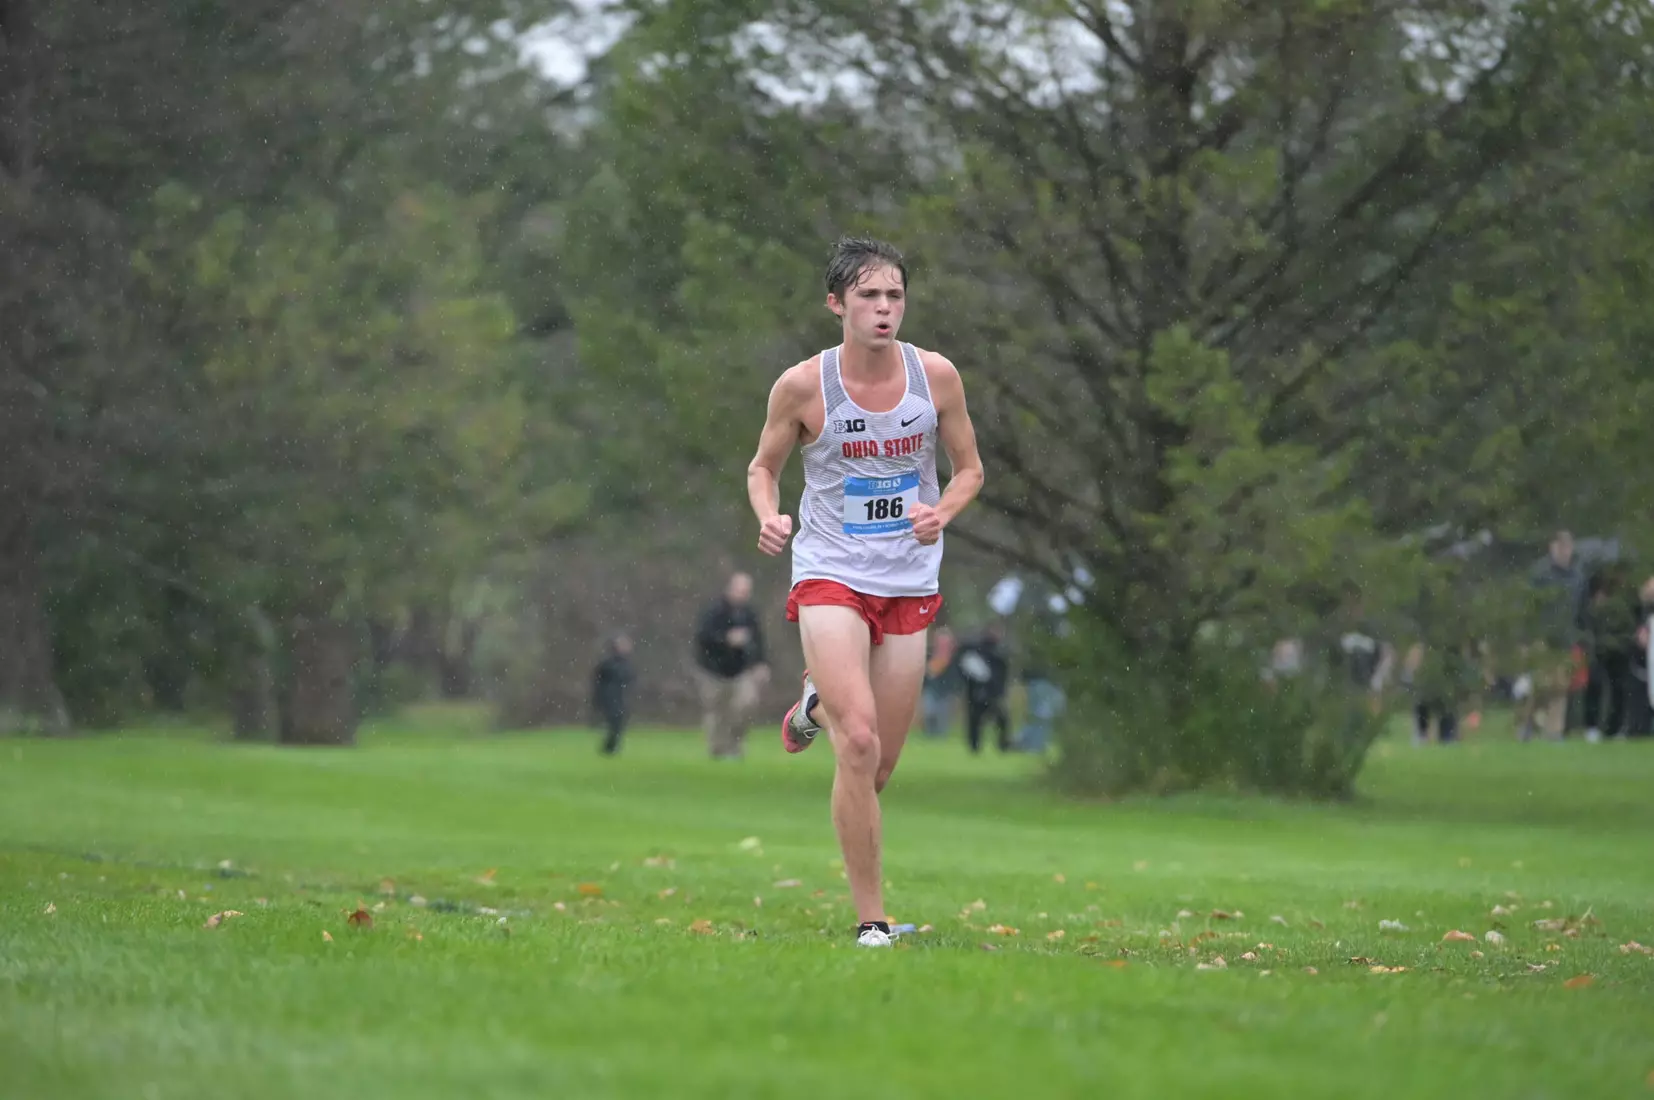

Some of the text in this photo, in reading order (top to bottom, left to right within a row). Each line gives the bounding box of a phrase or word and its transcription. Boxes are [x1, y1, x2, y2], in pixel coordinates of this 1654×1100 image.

[842, 432, 924, 458] OHIO STATE
[864, 497, 903, 520] 186
